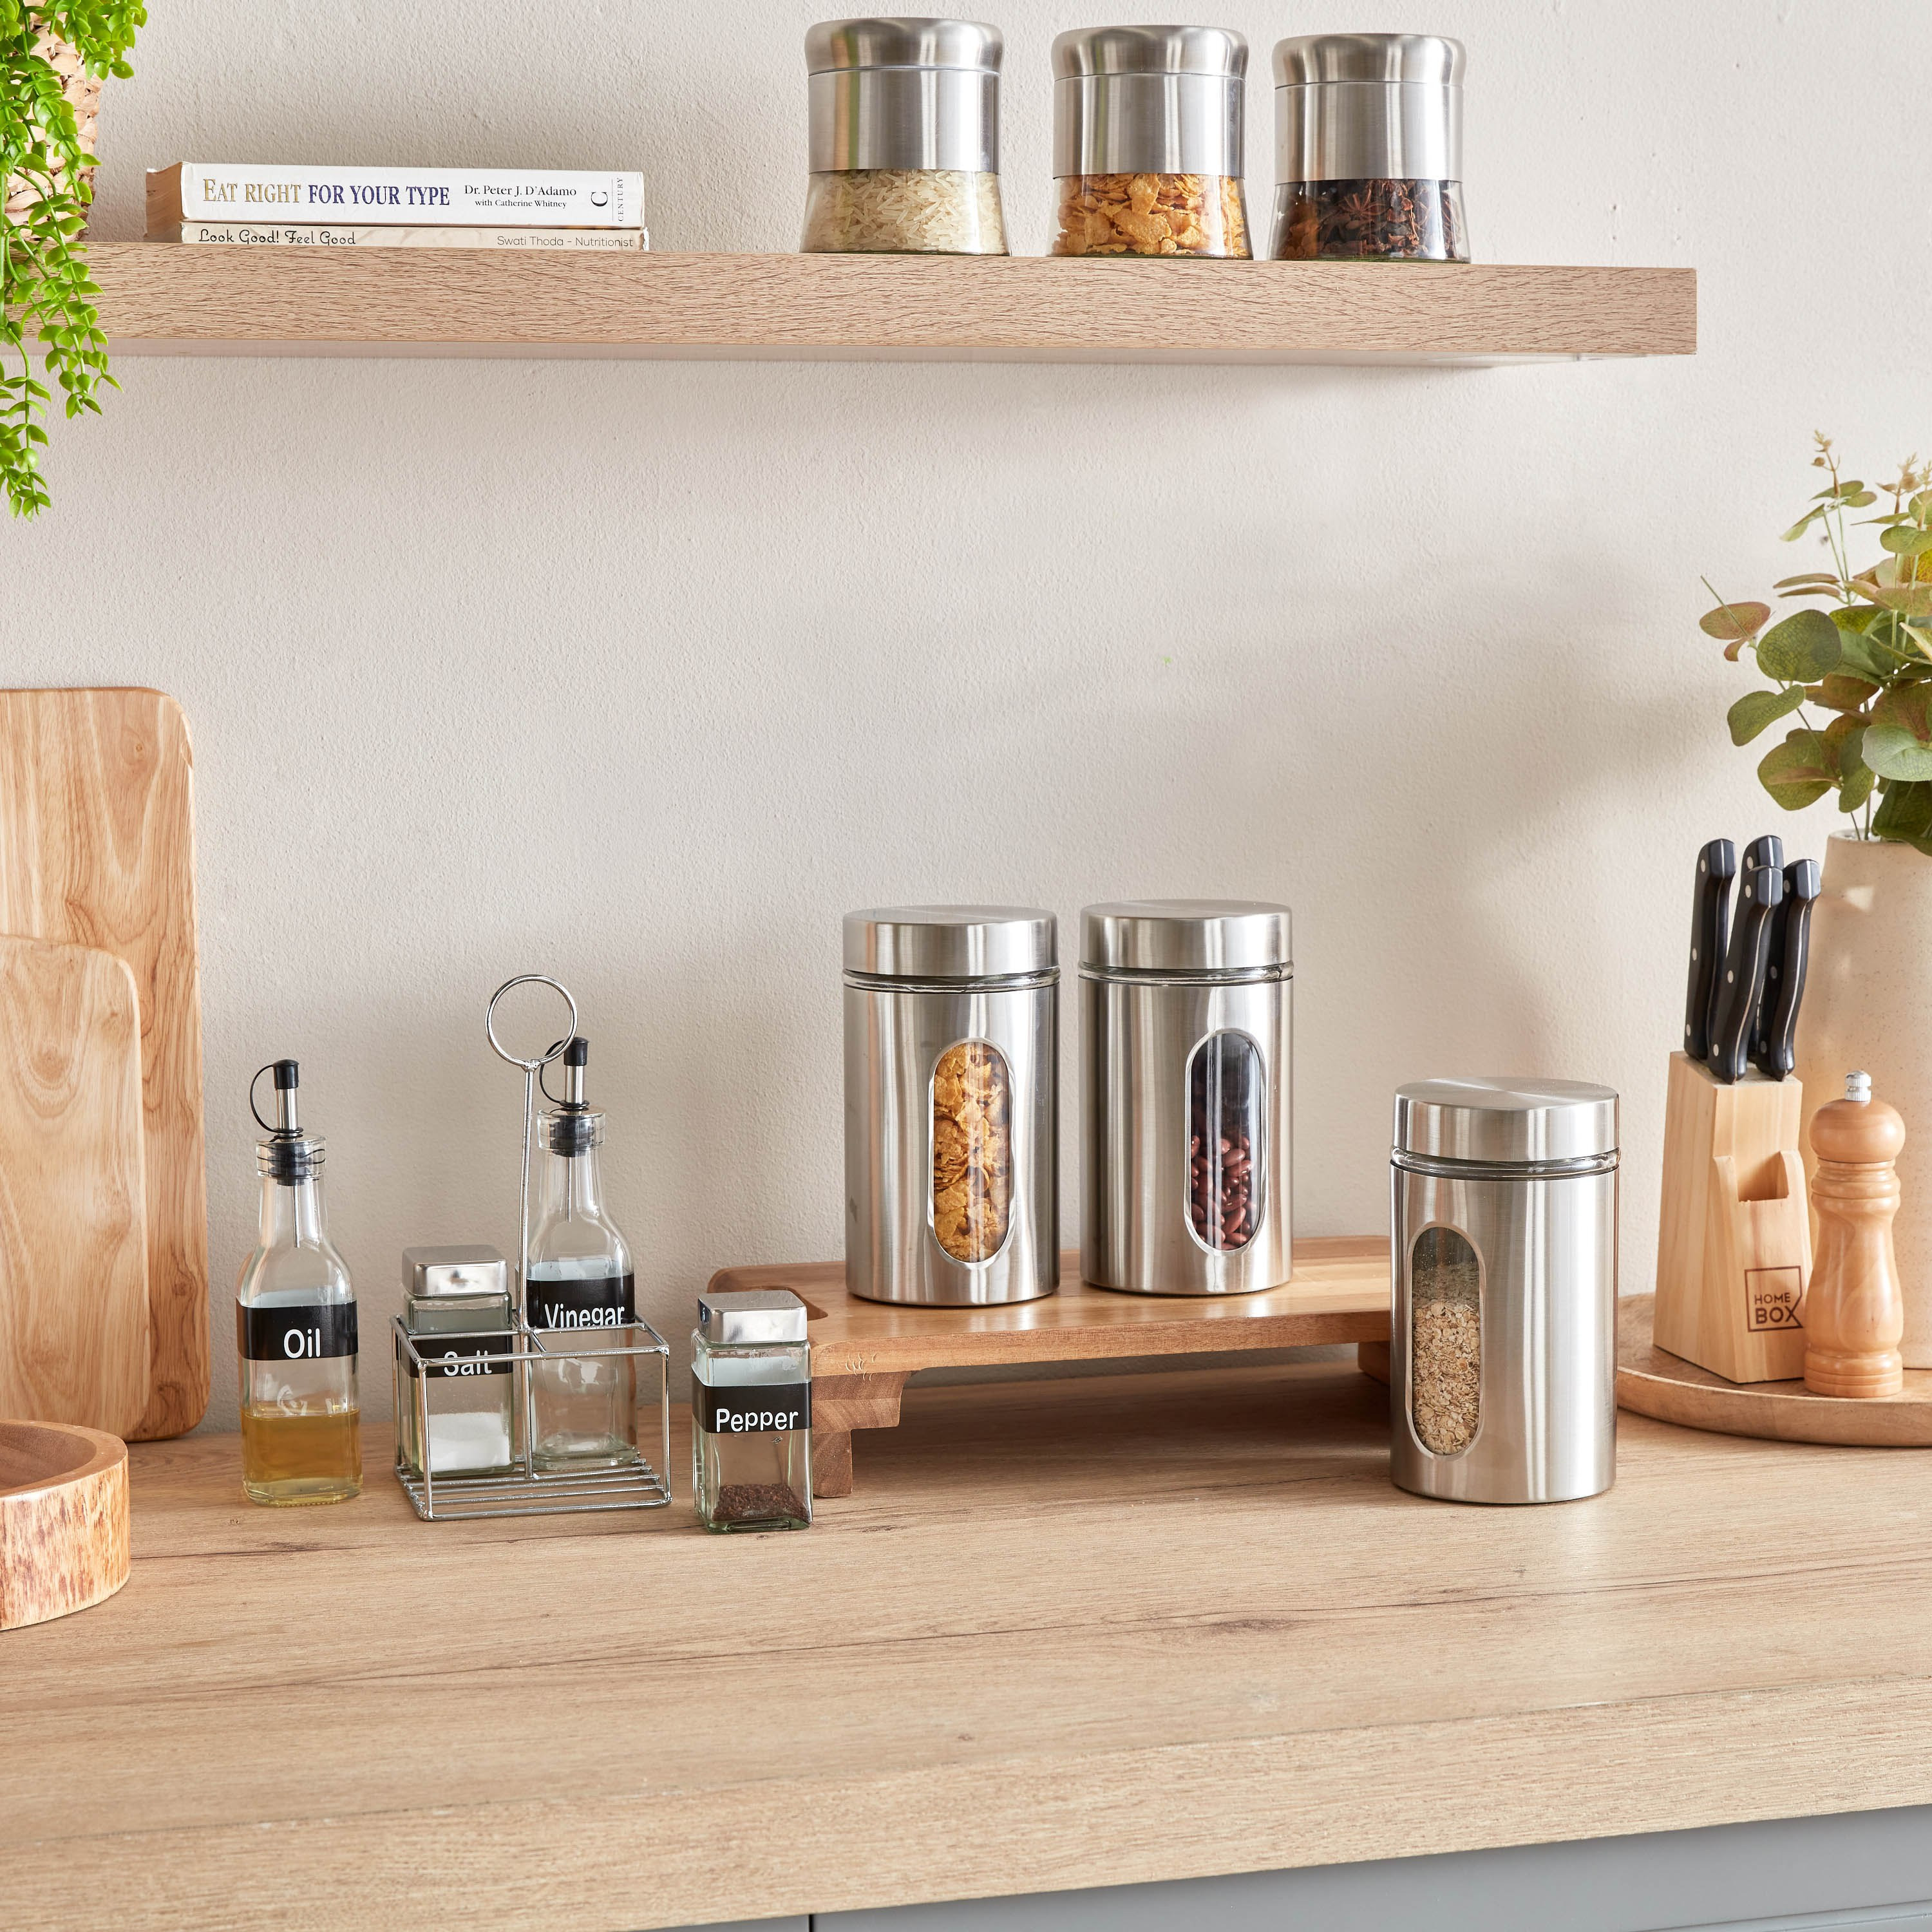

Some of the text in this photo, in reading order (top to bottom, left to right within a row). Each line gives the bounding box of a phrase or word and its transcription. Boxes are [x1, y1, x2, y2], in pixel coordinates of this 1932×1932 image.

[204, 178, 450, 205] EAT RIGHT FOR YOUR TYPE
[464, 185, 576, 197] Dr. Peter J. D'Adamo
[591, 191, 609, 207] C
[535, 200, 567, 209] Whitney
[198, 228, 356, 246] Look Good! Feel Good
[497, 236, 527, 246] Swati
[529, 236, 564, 247] Thoda
[575, 236, 633, 247] Nutritionist
[1754, 1292, 1791, 1305] HOME
[544, 1303, 625, 1329] Vinegar
[1756, 1306, 1799, 1325] BOX
[283, 1328, 321, 1359] Oil
[444, 1350, 492, 1376] Salt
[716, 1408, 799, 1433] Pepper
